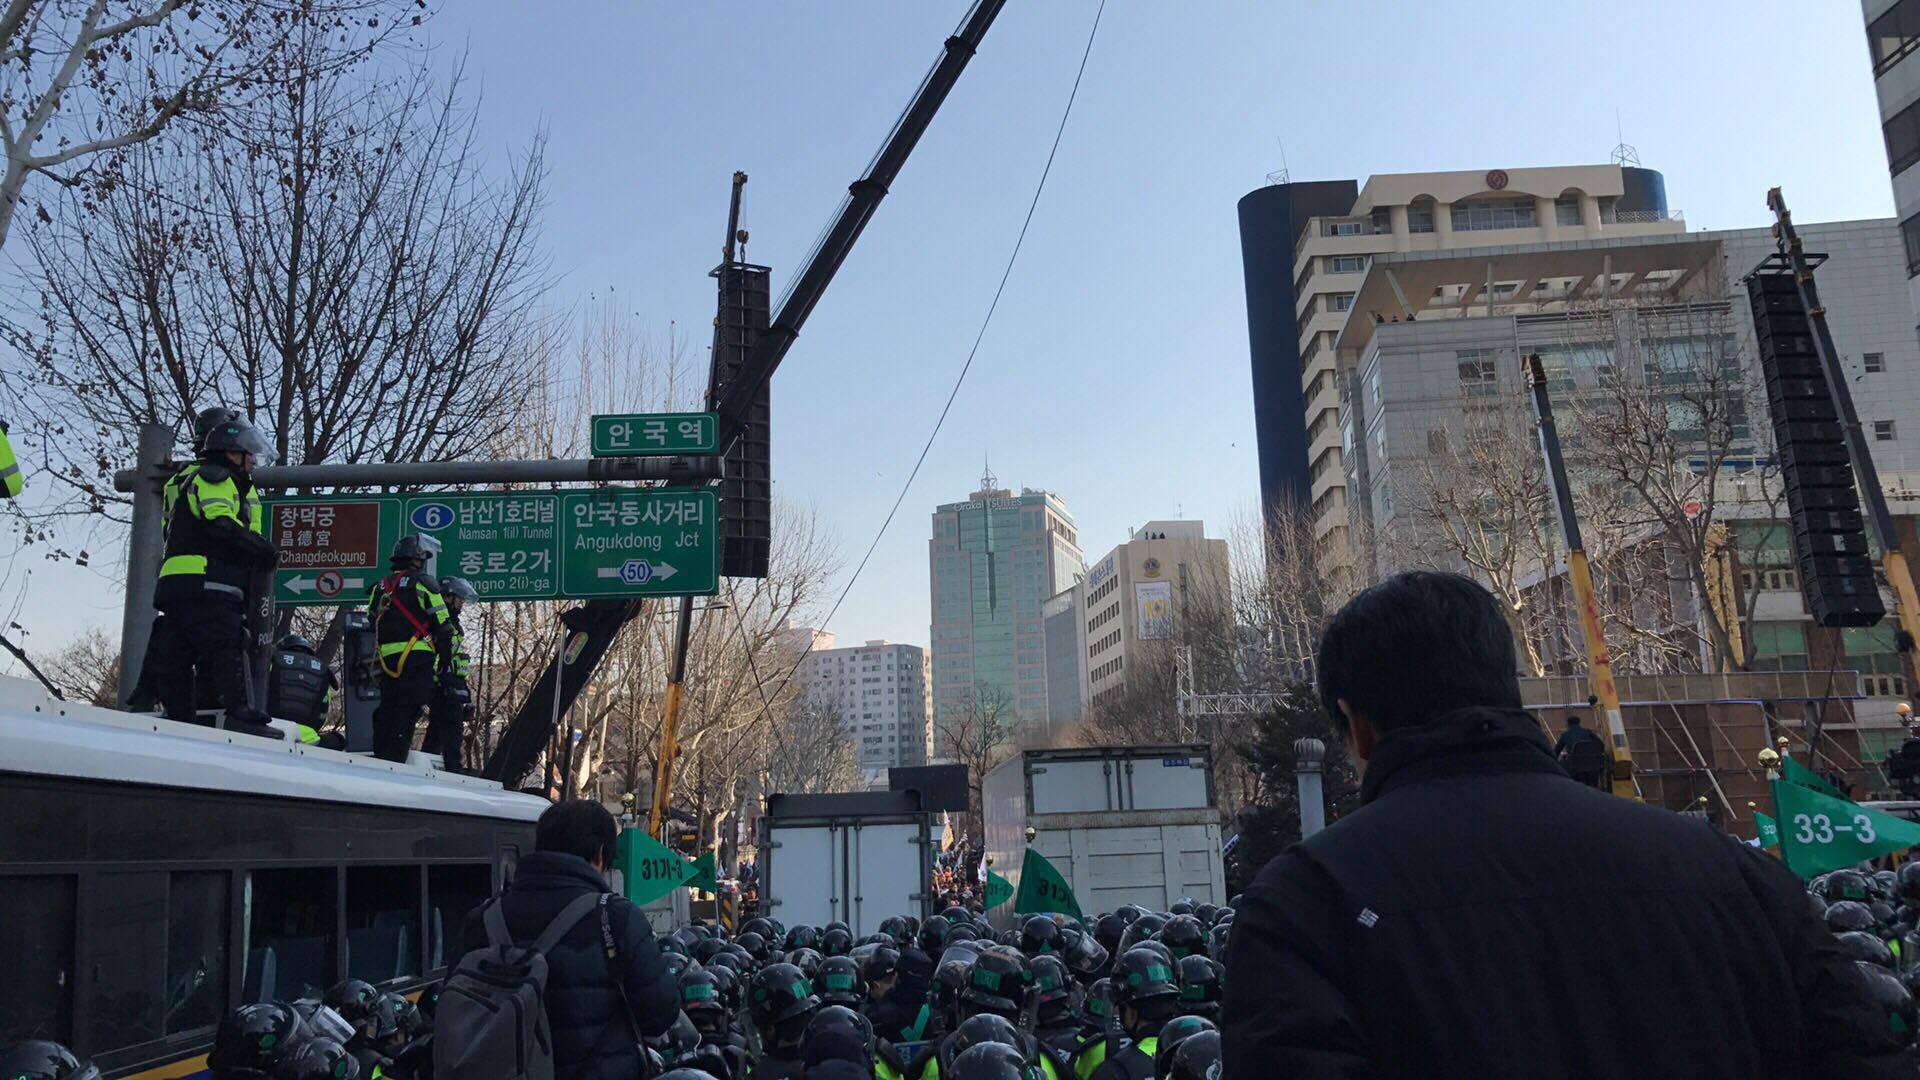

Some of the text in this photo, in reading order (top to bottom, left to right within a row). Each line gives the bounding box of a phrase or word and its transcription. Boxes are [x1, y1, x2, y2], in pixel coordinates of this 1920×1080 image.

[459, 499, 555, 525] 남산1호터널
[573, 500, 704, 528] 안국동사거리
[991, 498, 1022, 509] SUITES
[280, 506, 336, 528] 창덕궁
[425, 506, 441, 527] 6
[280, 530, 331, 547] 昌德宮
[458, 527, 498, 540] Namsan
[522, 526, 553, 539] Tunnel
[574, 531, 700, 552] Angukdong Jct
[280, 549, 366, 566] Changdeokgung
[459, 549, 552, 575] 종로2가
[627, 564, 647, 580] 50
[1793, 814, 1876, 844] 33-3
